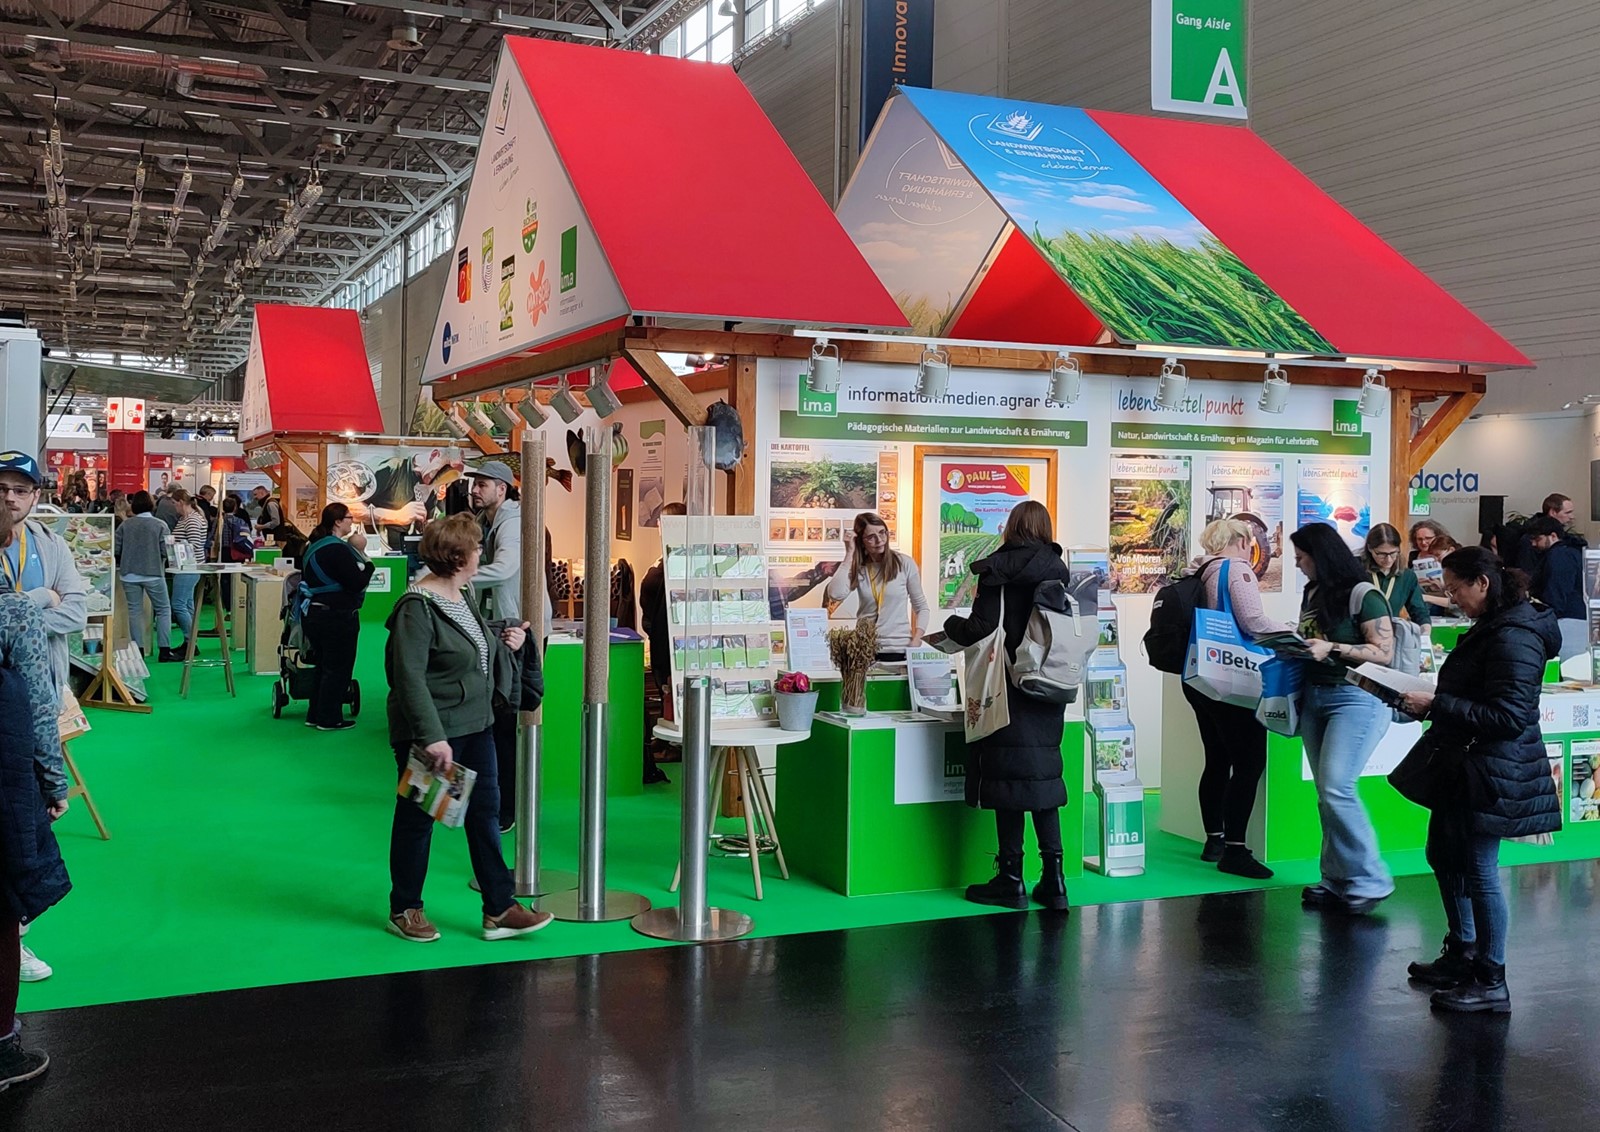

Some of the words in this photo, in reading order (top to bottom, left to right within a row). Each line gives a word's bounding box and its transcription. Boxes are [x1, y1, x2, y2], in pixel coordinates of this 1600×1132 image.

[1176, 13, 1202, 29] Gang
[1204, 17, 1231, 30] Aisle
[1203, 47, 1244, 107] A
[987, 139, 1086, 156] LANDWIRTSCHAFT
[847, 422, 903, 434] Pädagogische
[904, 424, 949, 434] Materialien
[965, 426, 1022, 437] Landwirtschaft
[1023, 428, 1030, 436] &
[1031, 428, 1070, 440] Ernährung
[1118, 431, 1140, 440] Natur,
[1141, 432, 1192, 441] Landwirtschaft
[1193, 434, 1199, 442] &
[1200, 434, 1235, 446] Ernährung
[1237, 435, 1245, 443] im
[1247, 436, 1274, 446] Magazin
[1275, 436, 1285, 445] für
[1286, 438, 1319, 446] Lehrkräfte
[966, 470, 991, 483] PAUL
[1117, 554, 1131, 564] Von
[1133, 554, 1161, 564] Mooren
[1122, 565, 1137, 575] und
[1138, 565, 1167, 575] Moosen
[1222, 650, 1259, 673] Betz
